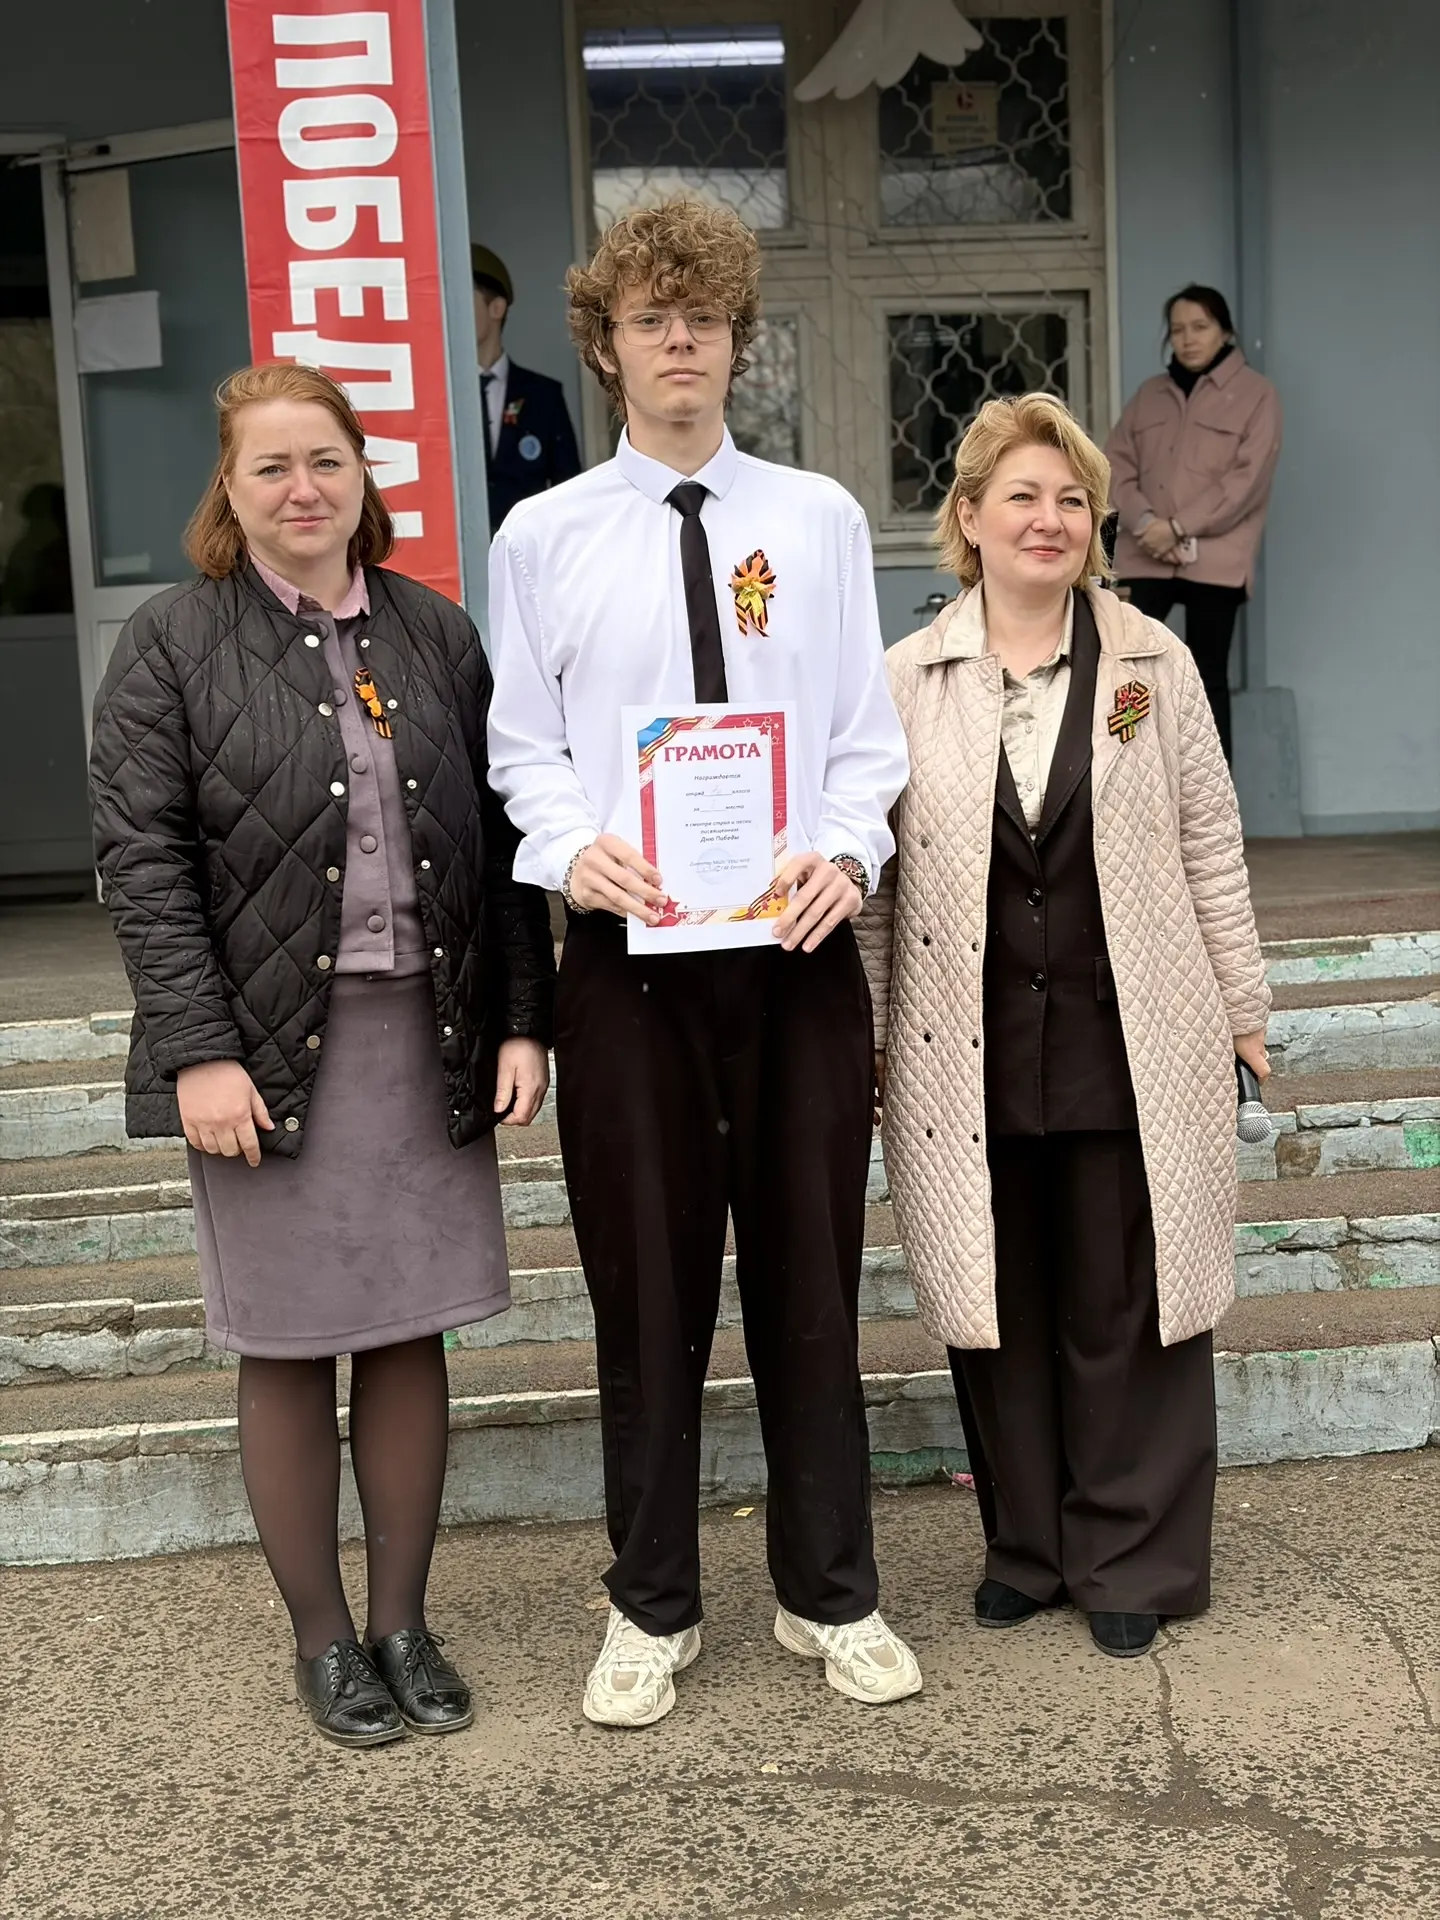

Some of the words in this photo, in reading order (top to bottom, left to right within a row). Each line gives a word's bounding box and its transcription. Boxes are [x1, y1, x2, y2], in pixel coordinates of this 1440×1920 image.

[271, 11, 424, 539] ПОБЕД
[664, 742, 761, 762] ГРАМОТА
[694, 773, 741, 782] Награждается
[715, 834, 740, 842] Победы
